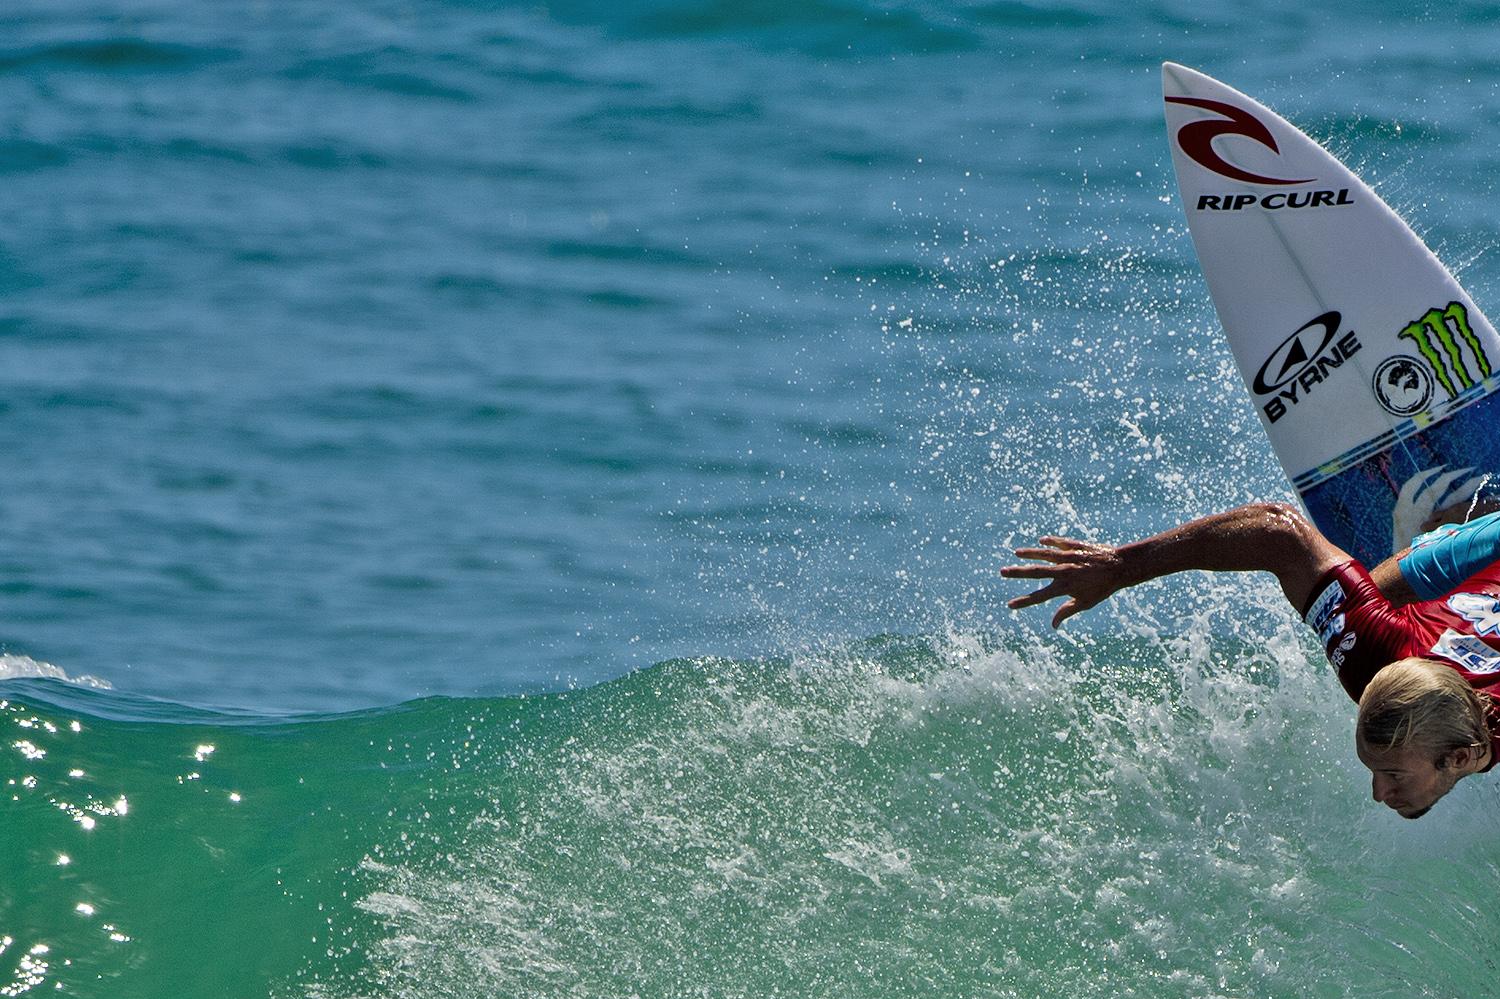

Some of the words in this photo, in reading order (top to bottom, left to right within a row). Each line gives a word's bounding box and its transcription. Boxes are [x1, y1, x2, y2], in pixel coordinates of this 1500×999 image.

[1196, 194, 1257, 211] RIP
[1260, 188, 1355, 210] CURL
[1262, 329, 1363, 425] BYRNE
